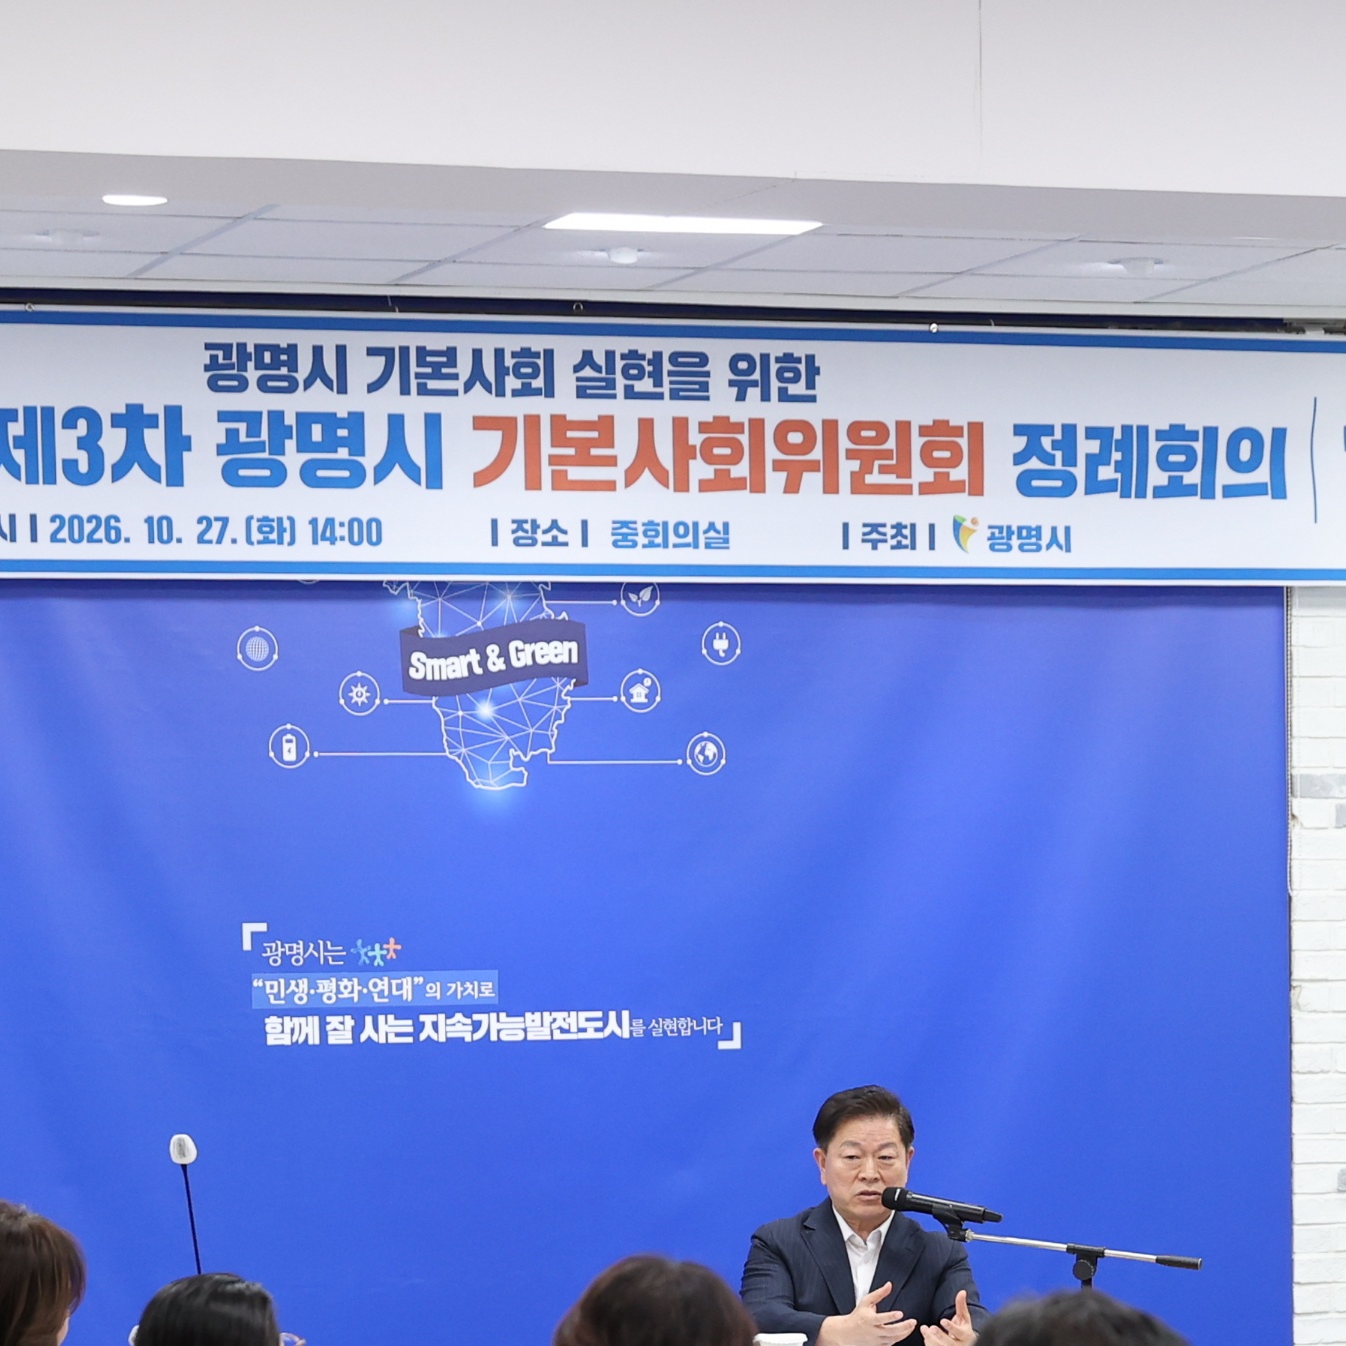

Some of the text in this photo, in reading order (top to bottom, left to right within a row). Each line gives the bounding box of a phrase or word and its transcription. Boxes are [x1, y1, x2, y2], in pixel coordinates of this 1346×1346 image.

[206, 343, 819, 402] 광명시 기본사회 실현을 위한
[217, 410, 443, 490] 광명시
[475, 415, 983, 495] 기본사회위원회
[1013, 423, 1287, 500] 정례회의
[50, 514, 130, 544] 2026.
[145, 515, 182, 544] 10.
[309, 517, 382, 546] 14:00
[512, 519, 730, 550] 장소 중회의실
[863, 523, 1071, 553] 주최 광명시
[409, 640, 578, 680] Smart & Green
[447, 981, 495, 999] 가치로
[265, 1010, 723, 1045] 함께 잘 사는 지속가능발전도시를 실현합니다
